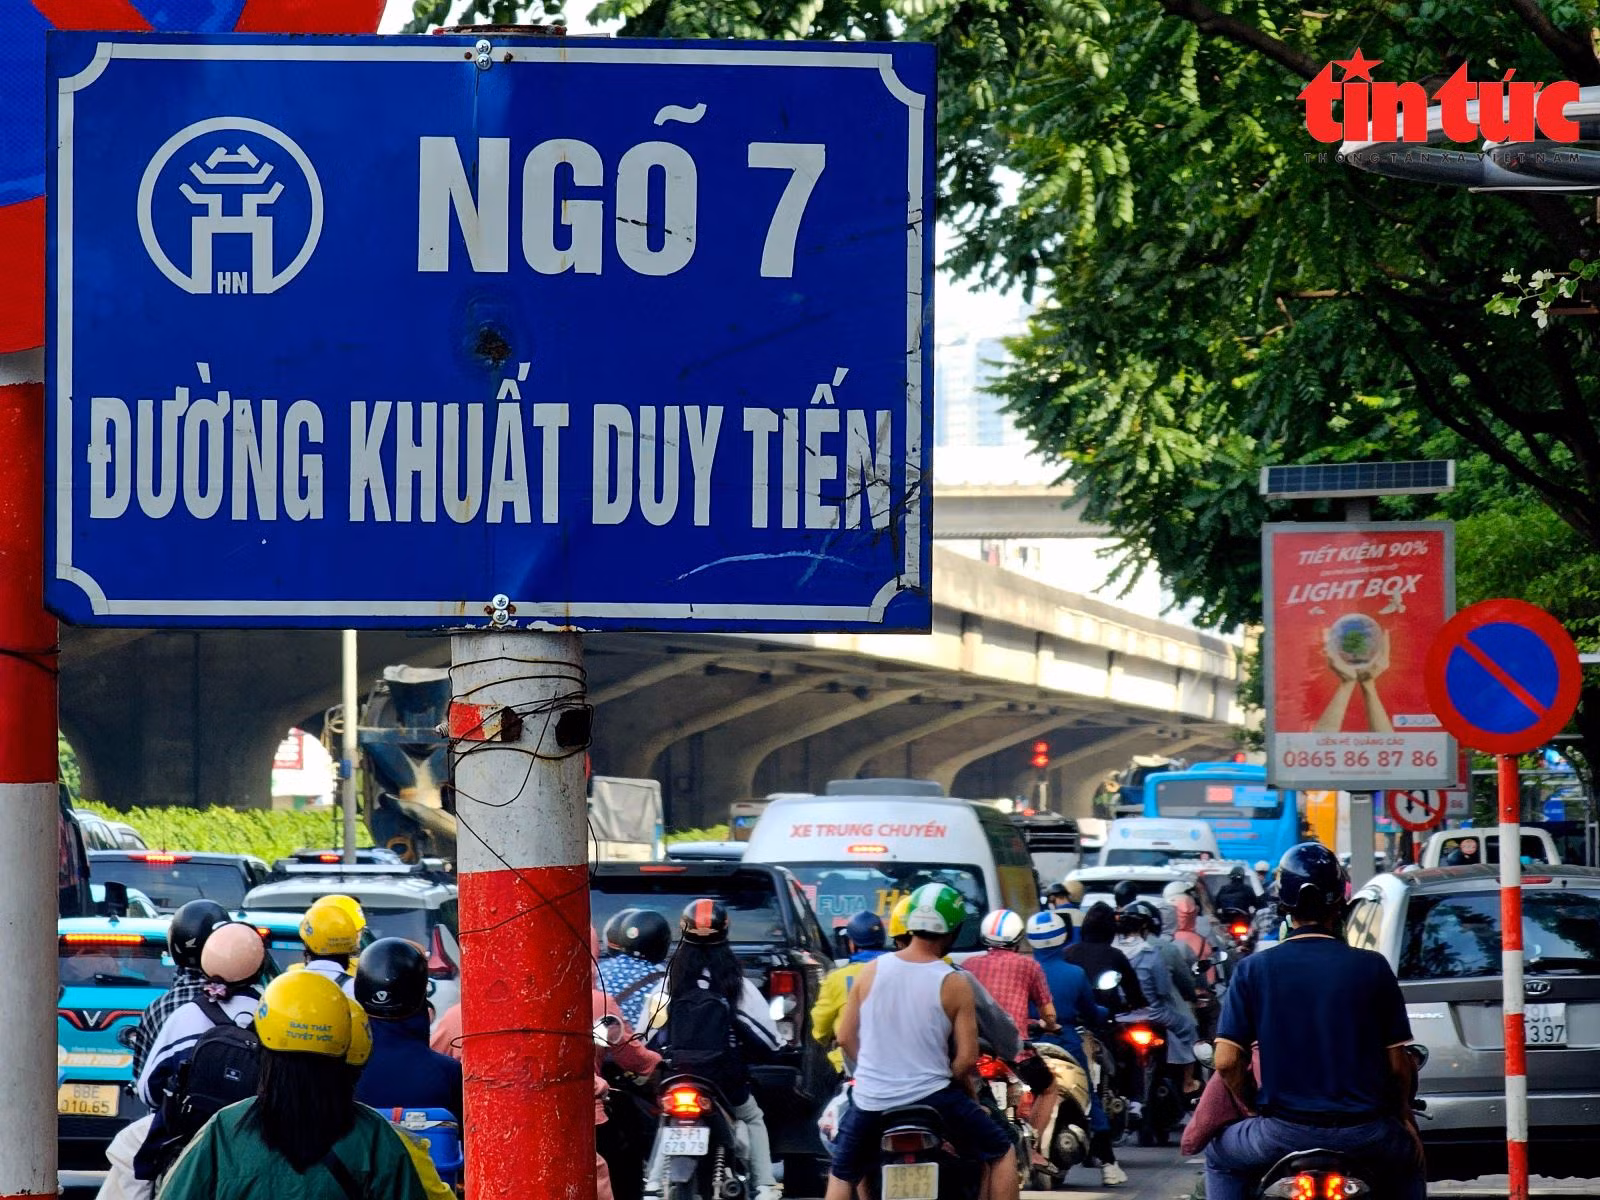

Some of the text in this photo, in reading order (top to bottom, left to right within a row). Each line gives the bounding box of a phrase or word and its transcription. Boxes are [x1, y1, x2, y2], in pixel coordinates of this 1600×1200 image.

[418, 103, 825, 277] NGÕ 7
[217, 271, 248, 294] HN
[88, 362, 891, 529] ĐƯỜNG KHUẤT DUY TIẾN
[1389, 540, 1428, 558] 90%
[1288, 574, 1423, 604] LIGHT BOX
[1283, 750, 1438, 768] 0865 86 87 86
[790, 824, 812, 838] XE
[816, 823, 873, 837] TRUNG
[816, 893, 868, 916] FUTA
